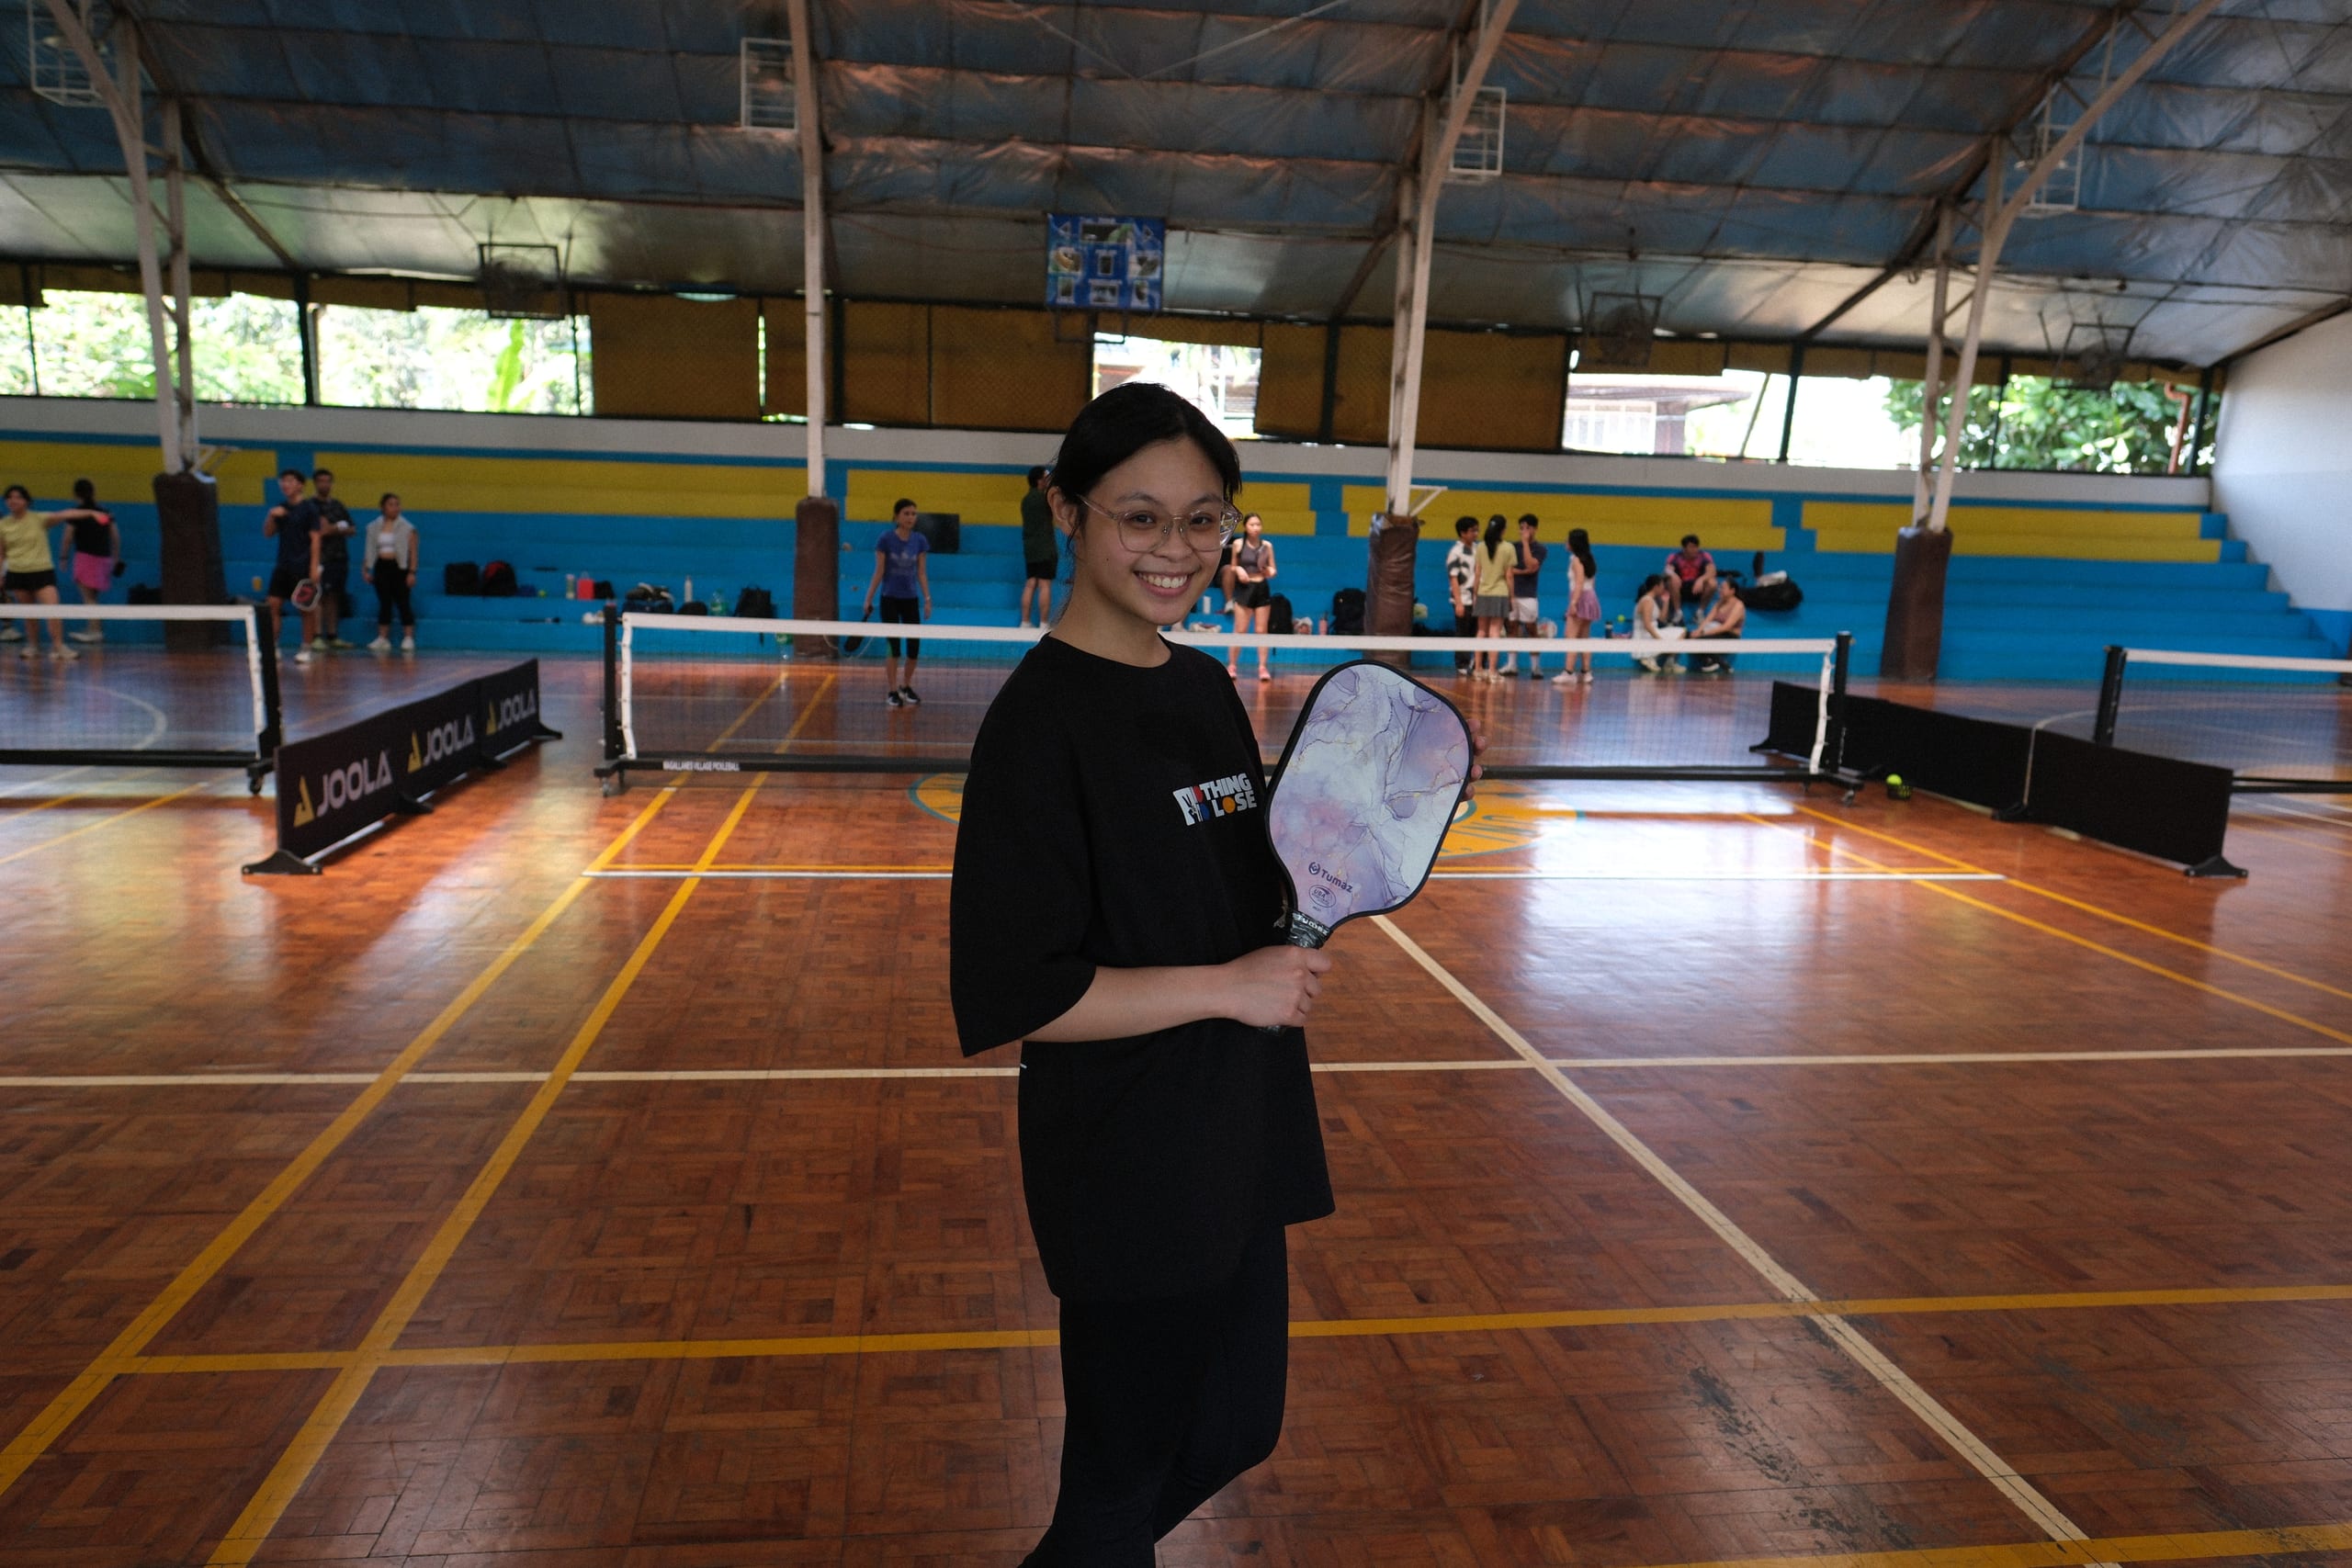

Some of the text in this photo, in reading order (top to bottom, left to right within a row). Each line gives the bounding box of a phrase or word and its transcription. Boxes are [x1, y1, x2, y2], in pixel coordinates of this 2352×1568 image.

[496, 689, 537, 731] JOOLA
[423, 714, 475, 766] JOOLA
[316, 749, 393, 818] JOOLA
[1212, 790, 1257, 818] LOSE
[1321, 869, 1353, 893] Tumaz
